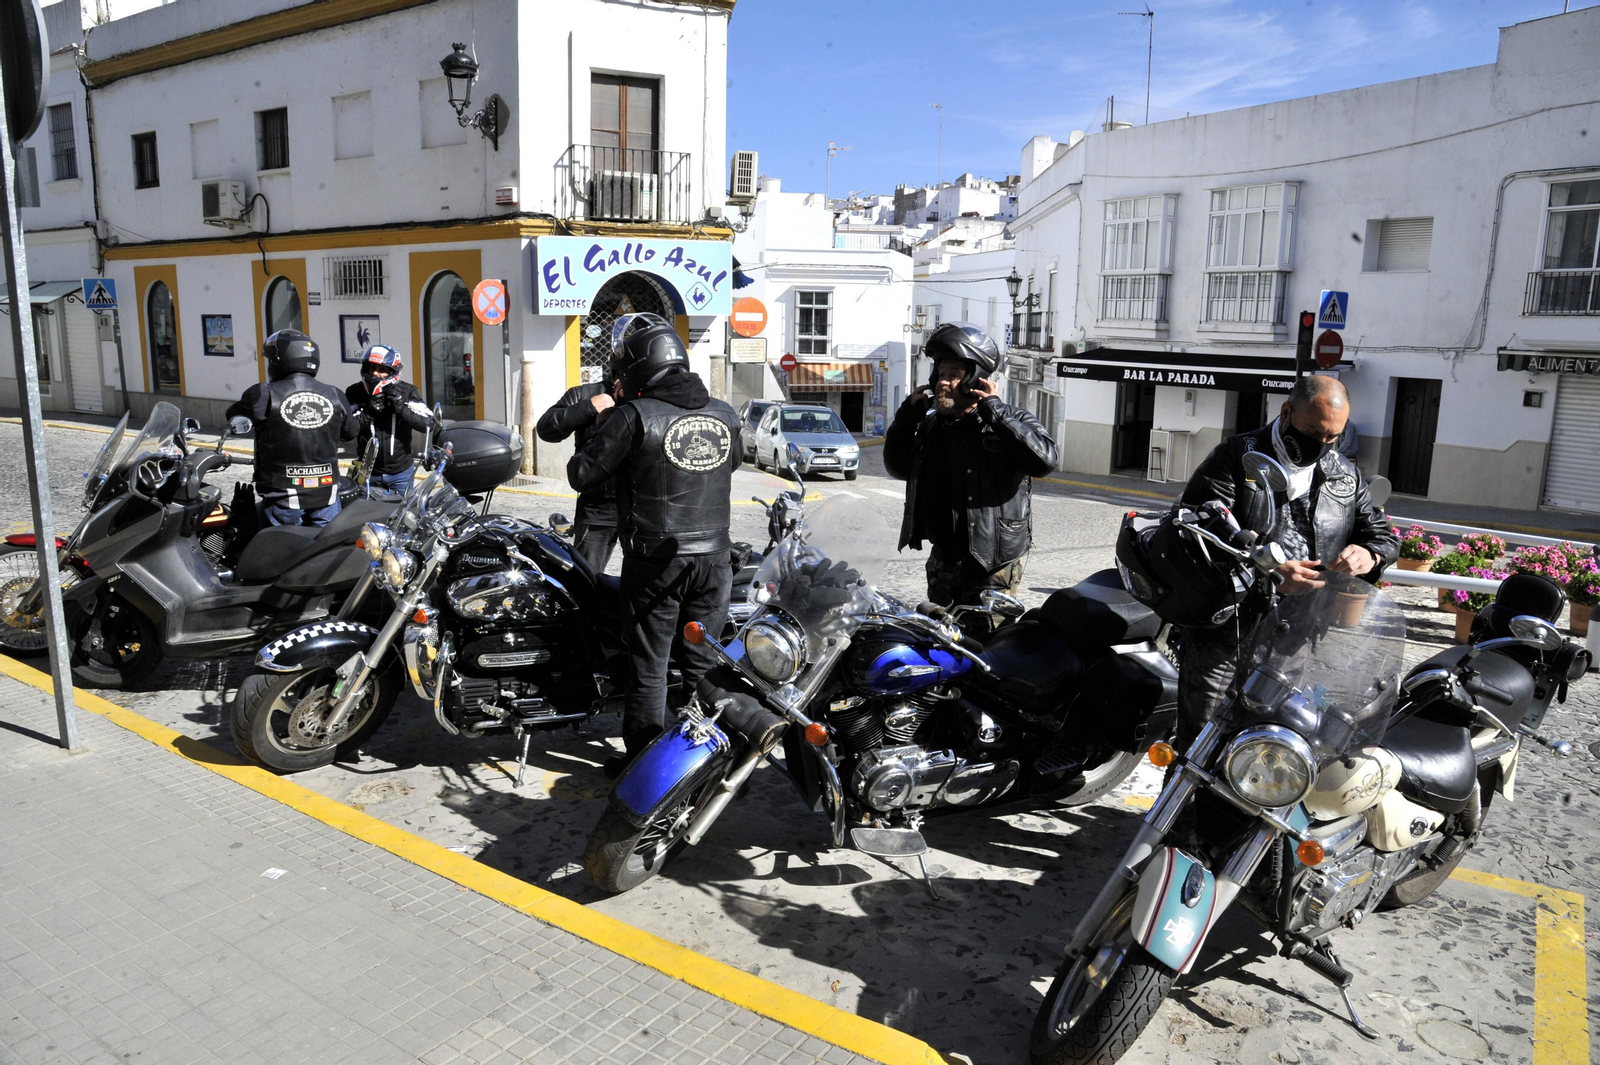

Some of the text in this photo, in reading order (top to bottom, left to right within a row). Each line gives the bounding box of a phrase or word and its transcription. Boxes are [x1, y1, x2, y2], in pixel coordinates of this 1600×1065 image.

[542, 242, 728, 294] El Gallo Azul
[543, 298, 587, 309] DEPORTES
[1062, 365, 1088, 375] Cruzcampo
[1123, 369, 1216, 386] BAR LA PARADA
[671, 442, 681, 450] 19
[288, 466, 331, 475] CACHANILLA
